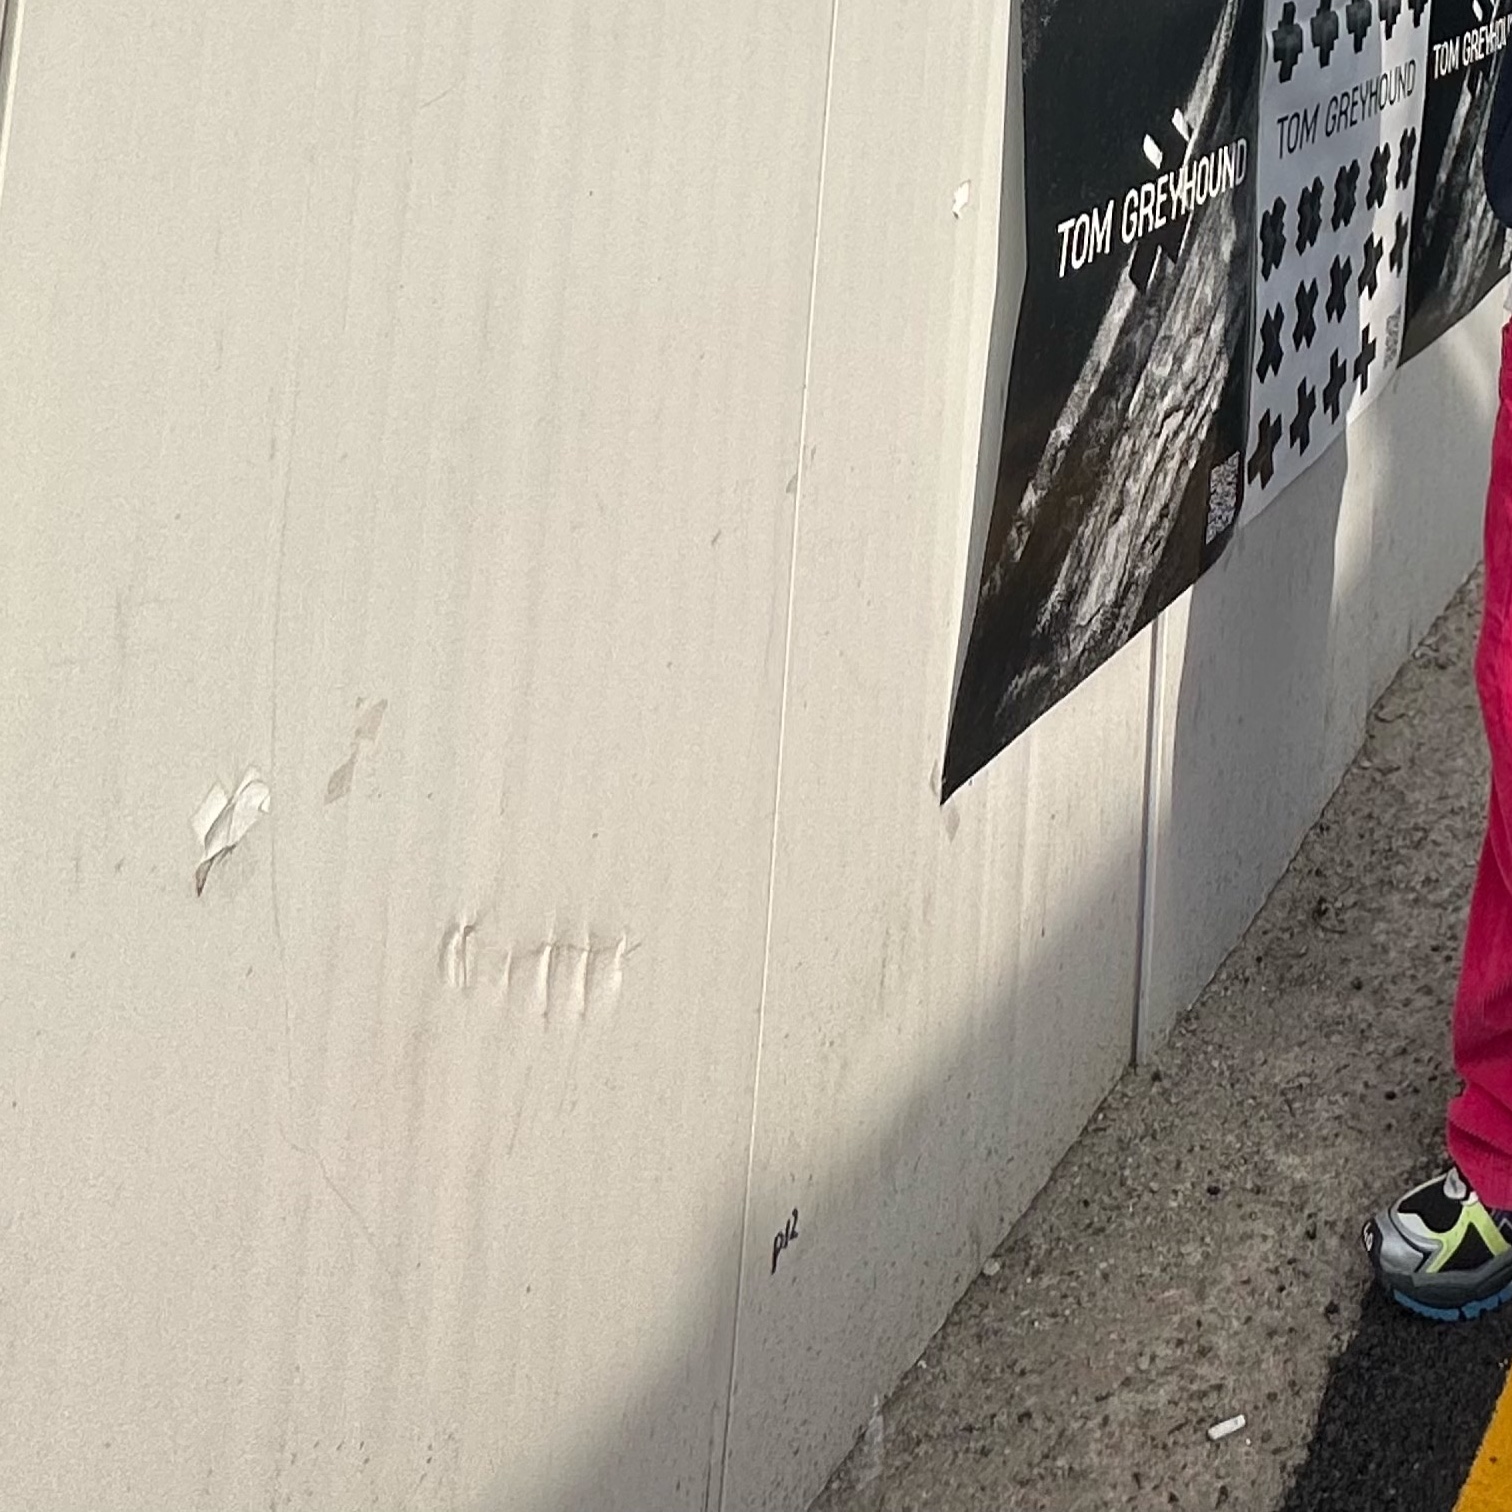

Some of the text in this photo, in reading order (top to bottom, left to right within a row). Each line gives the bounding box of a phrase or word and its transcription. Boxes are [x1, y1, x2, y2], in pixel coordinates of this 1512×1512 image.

[1432, 35, 1461, 80] TOM
[1277, 58, 1416, 159] TOM GREYHOUND
[1057, 138, 1247, 278] TOM GREYHOUND
